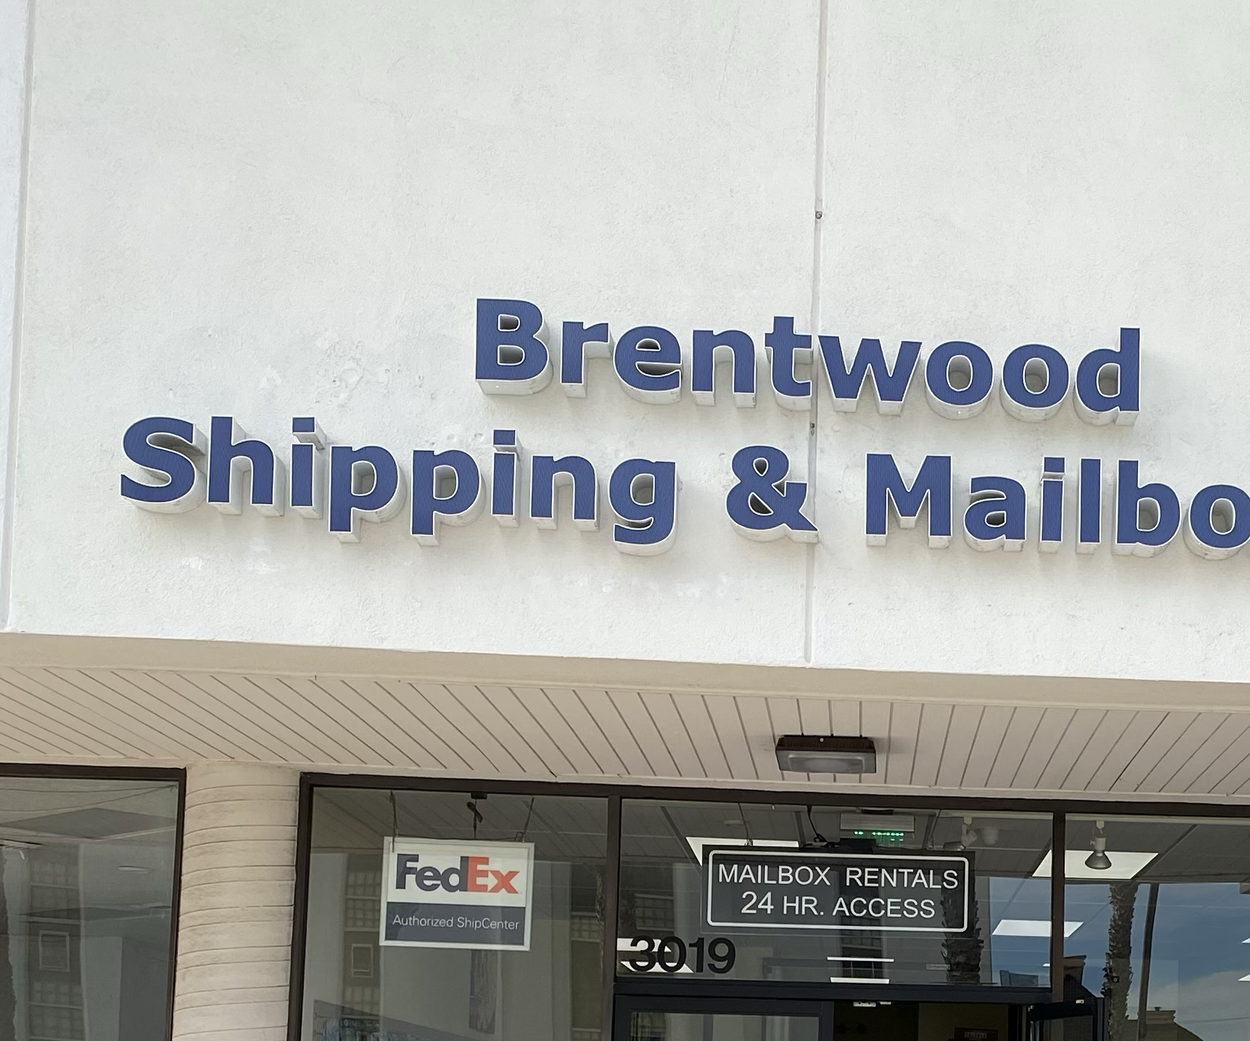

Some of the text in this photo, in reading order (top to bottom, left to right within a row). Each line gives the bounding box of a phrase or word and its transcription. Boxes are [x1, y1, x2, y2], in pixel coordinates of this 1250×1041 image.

[475, 297, 1142, 416] Brentwood
[120, 415, 678, 545] Shipping
[725, 444, 819, 536] &
[395, 853, 521, 894] FedEx
[717, 863, 959, 890] MAILBOX RENTALS
[392, 914, 520, 931] Authorized ShipCenter
[740, 891, 937, 919] 24 HR. ACCESS
[628, 935, 737, 974] 3019
